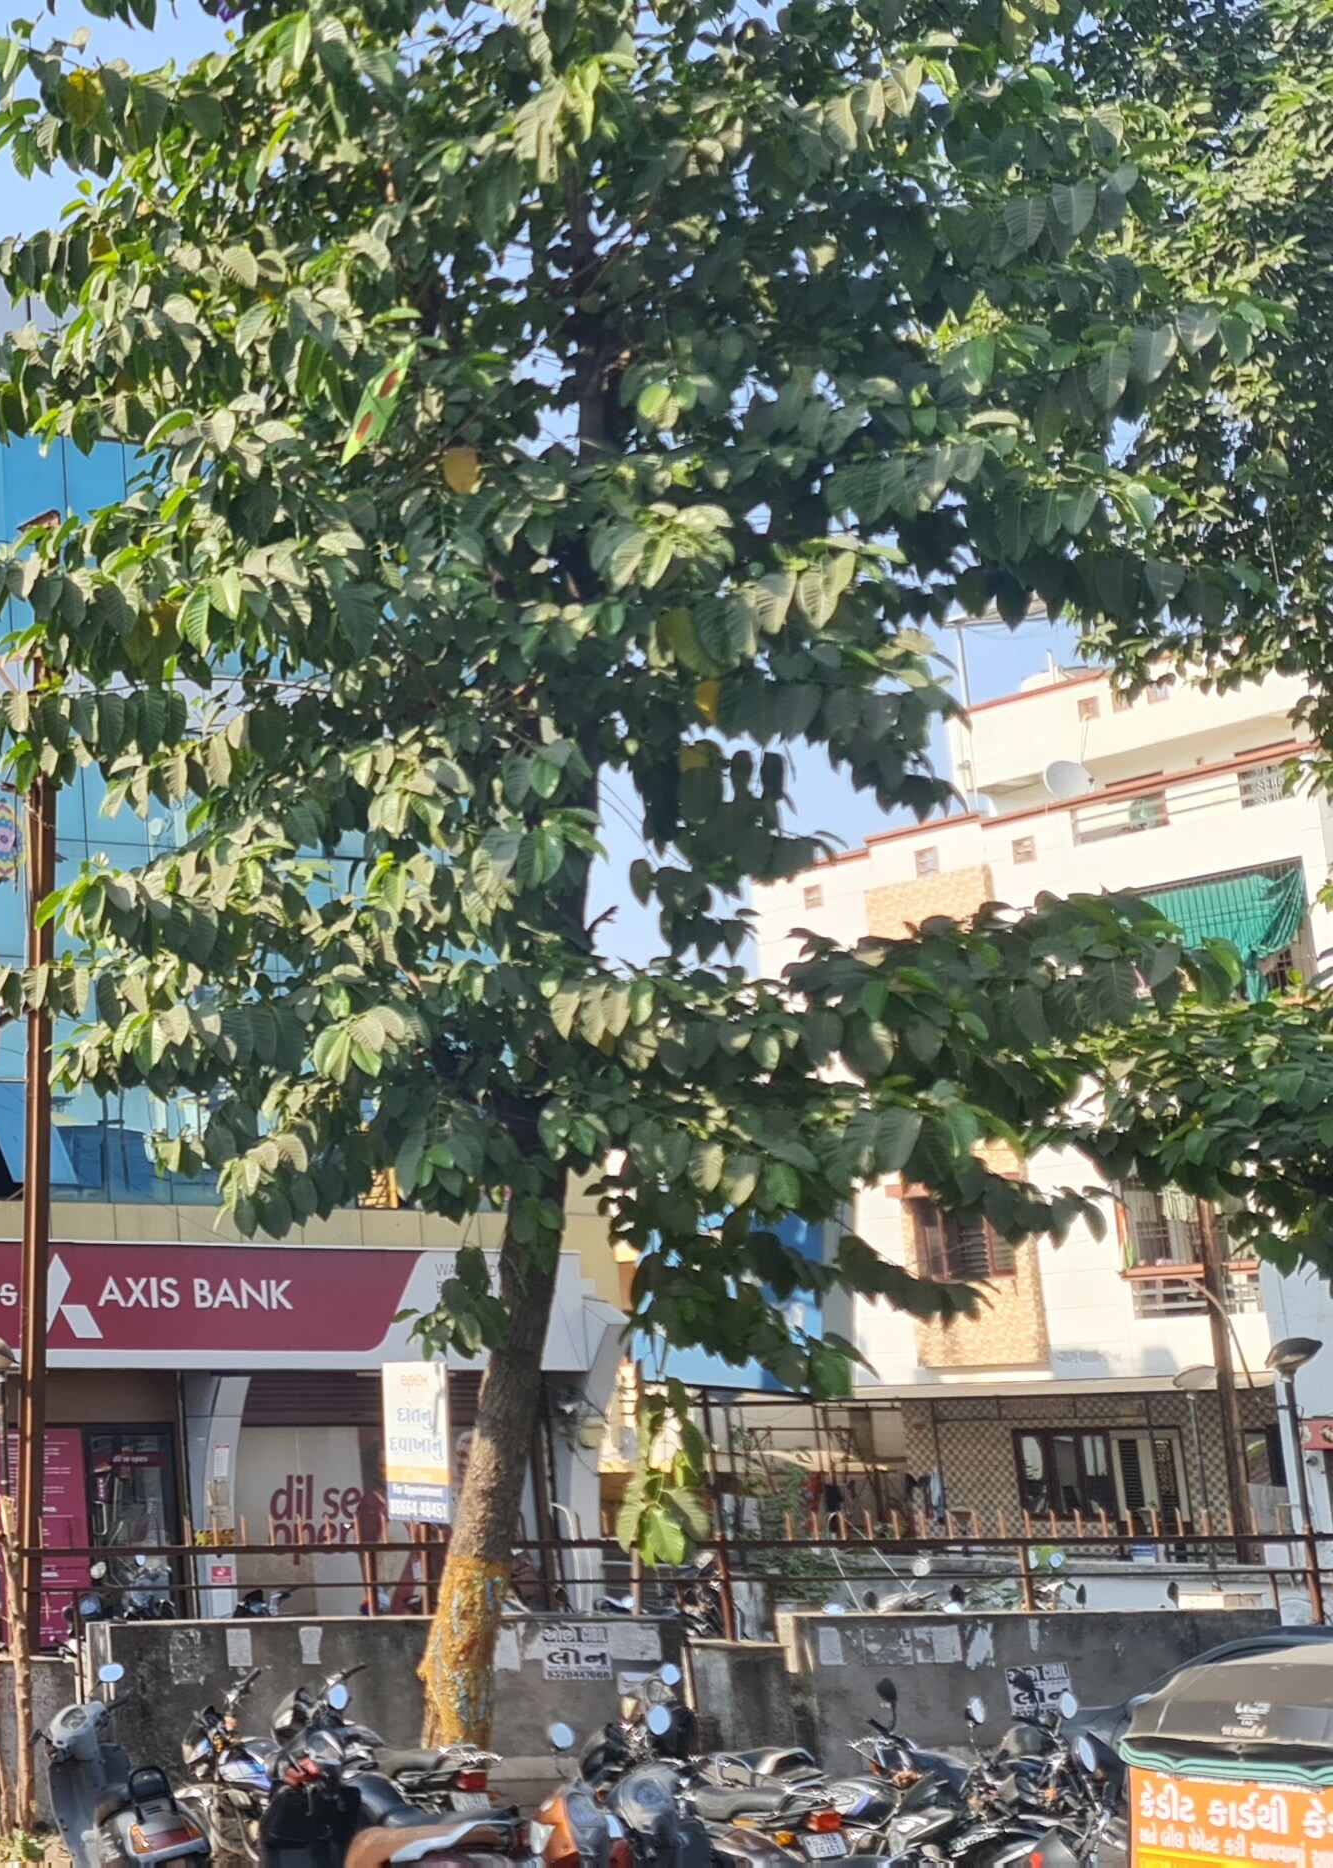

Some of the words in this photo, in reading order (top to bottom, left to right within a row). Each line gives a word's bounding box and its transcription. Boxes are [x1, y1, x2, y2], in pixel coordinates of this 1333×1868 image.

[97, 1276, 179, 1310] AXIS
[194, 1278, 293, 1311] BANK
[269, 1474, 314, 1521] dil
[322, 1487, 362, 1520] se
